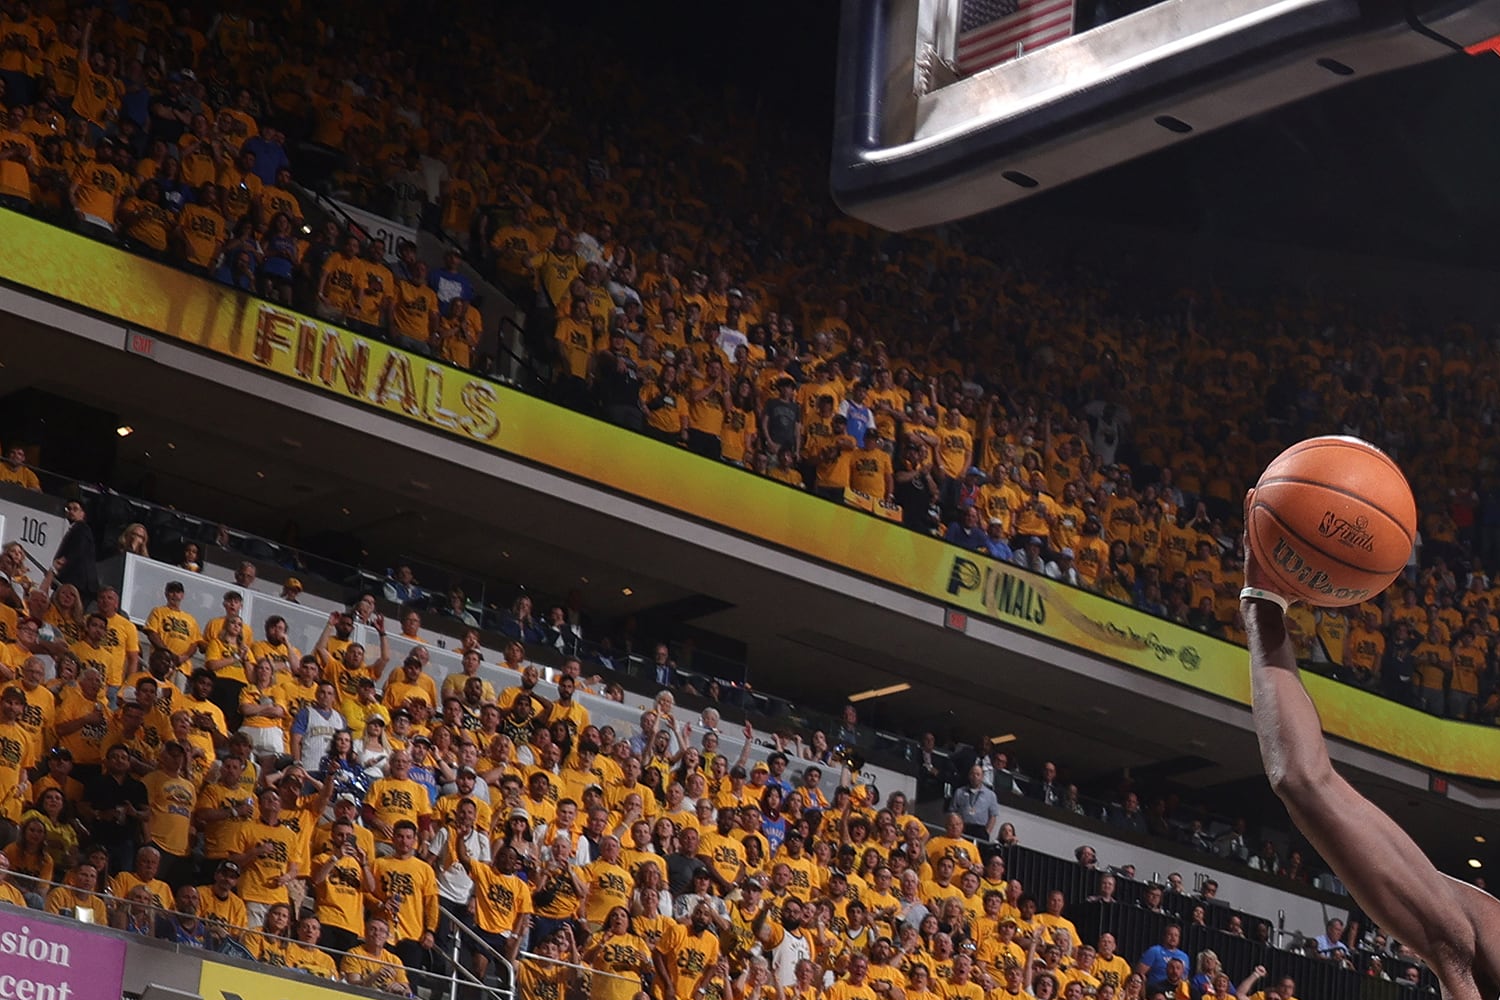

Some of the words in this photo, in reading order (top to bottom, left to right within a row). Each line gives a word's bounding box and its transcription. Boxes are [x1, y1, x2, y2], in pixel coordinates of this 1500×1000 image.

[252, 303, 501, 442] FINALS
[20, 514, 47, 547] 106
[1333, 518, 1376, 553] Finals
[0, 926, 71, 968] sion
